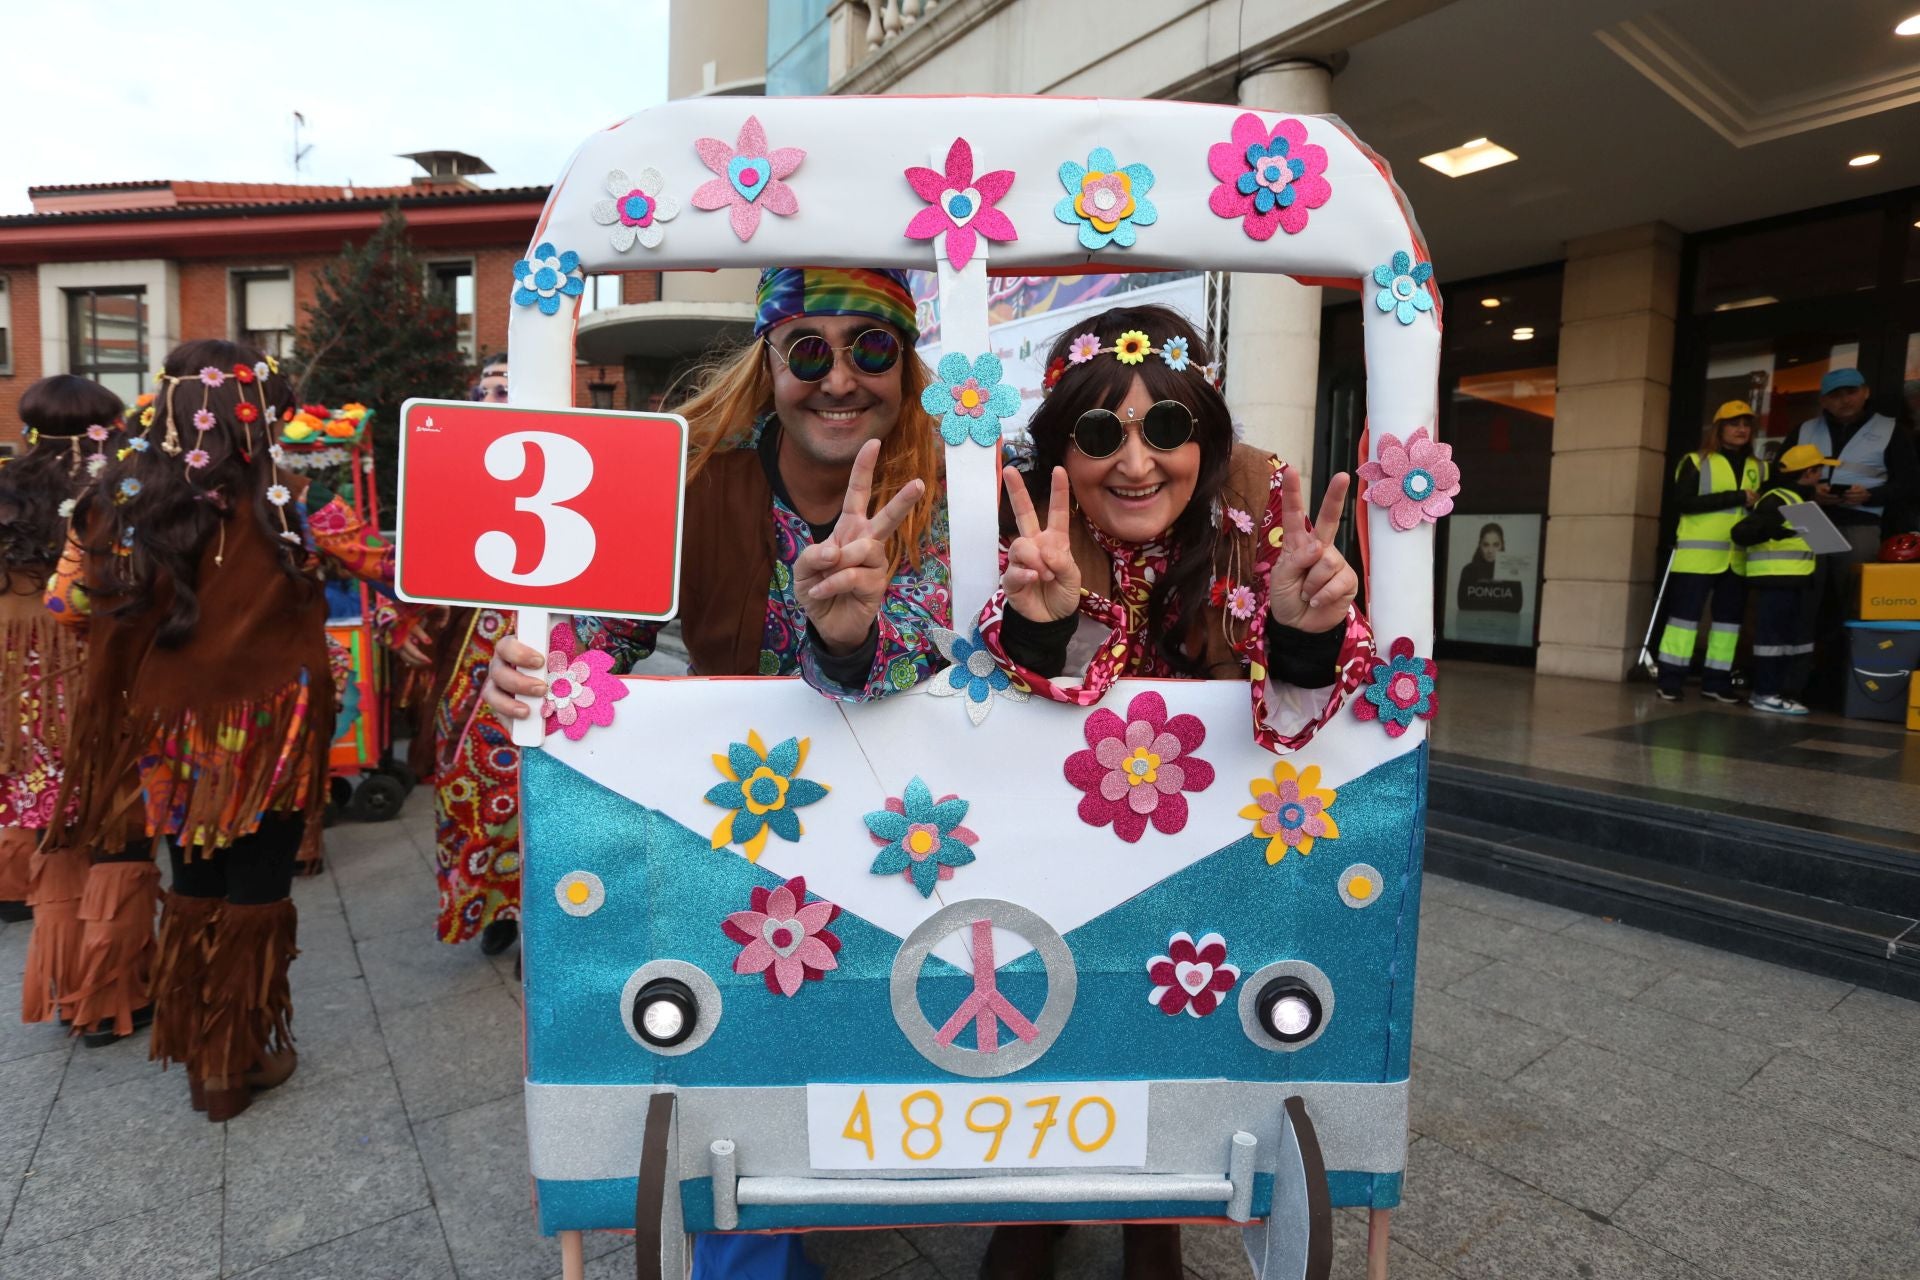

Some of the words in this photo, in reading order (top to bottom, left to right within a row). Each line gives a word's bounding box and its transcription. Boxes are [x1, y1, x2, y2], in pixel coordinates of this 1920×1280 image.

[474, 430, 596, 587] 3
[1467, 586, 1513, 599] PONCIA
[841, 1088, 1117, 1162] 48970
